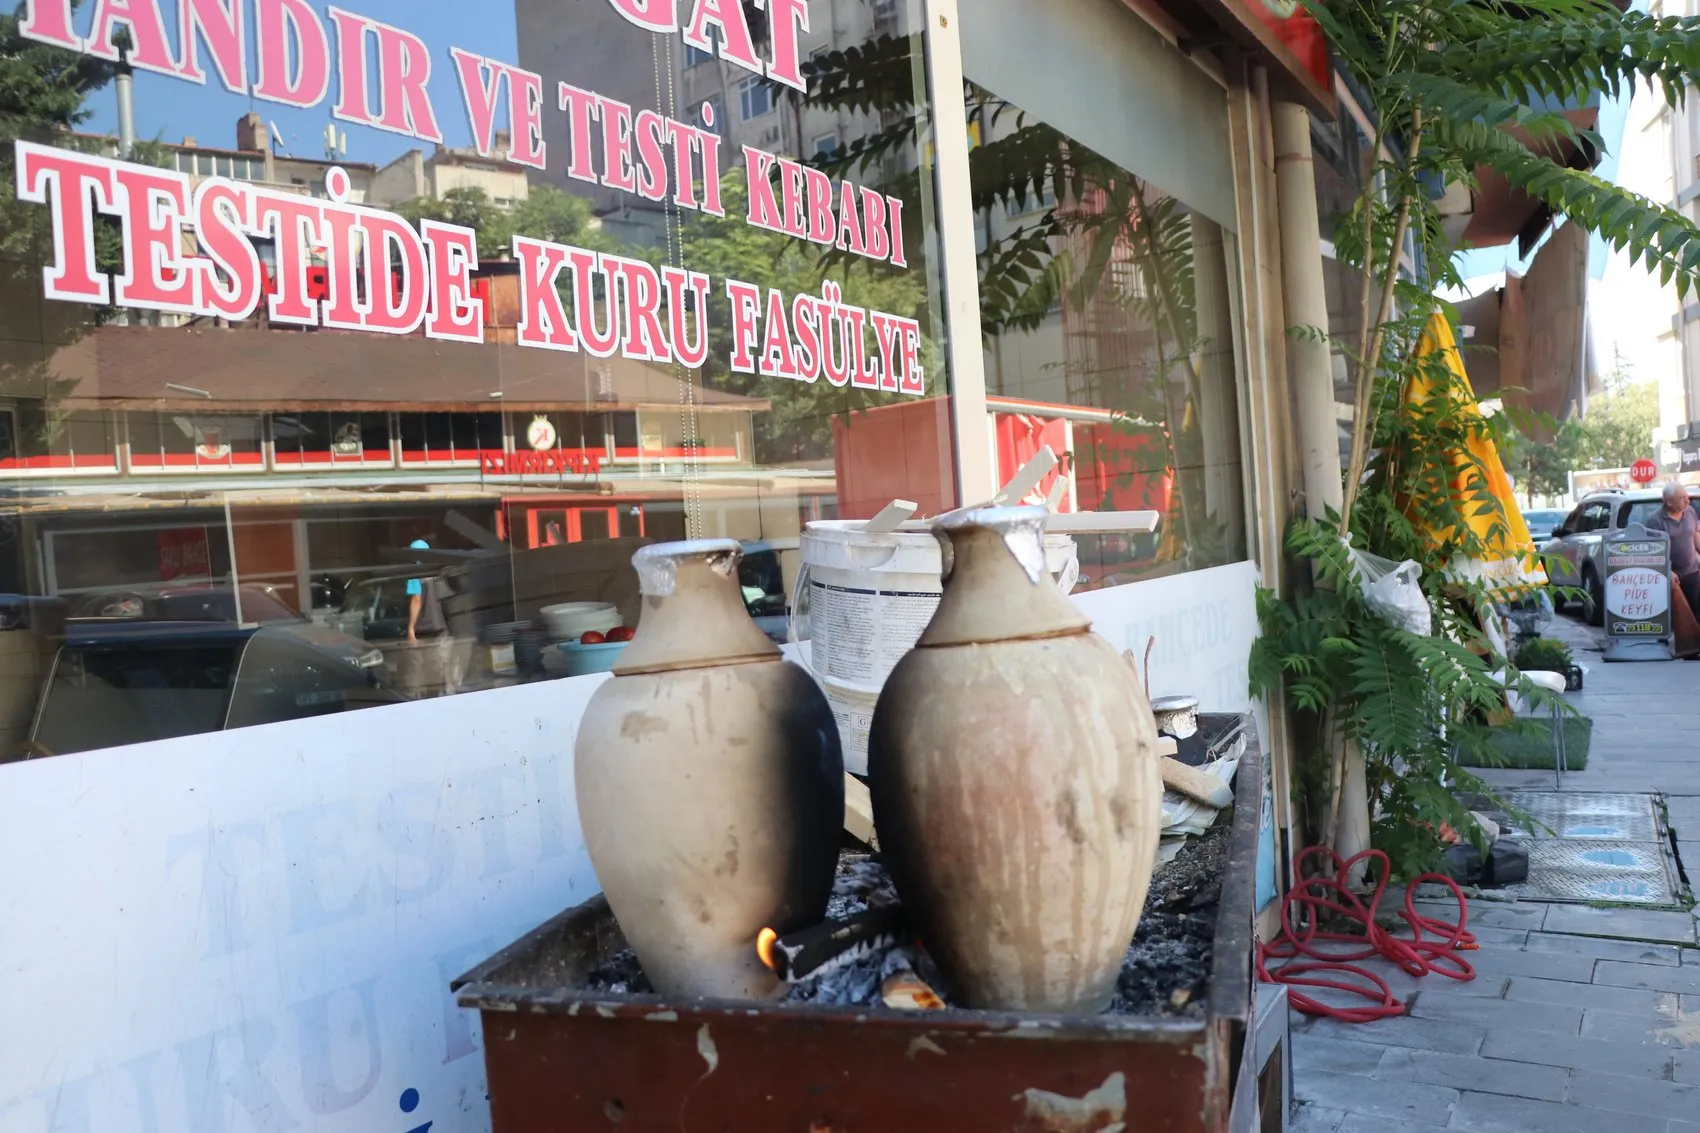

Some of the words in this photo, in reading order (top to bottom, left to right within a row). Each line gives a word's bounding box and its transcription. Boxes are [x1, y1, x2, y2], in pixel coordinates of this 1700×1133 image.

[608, 0, 810, 94] AT
[451, 47, 546, 170] VE
[558, 81, 726, 218] TESTİ
[742, 144, 908, 268] KEBABI
[14, 140, 484, 344] TESTİDE
[513, 235, 710, 369] KURU
[726, 279, 925, 396] FASÜLYE
[1631, 466, 1655, 478] DUR
[1612, 573, 1661, 586] BAHÇEDE
